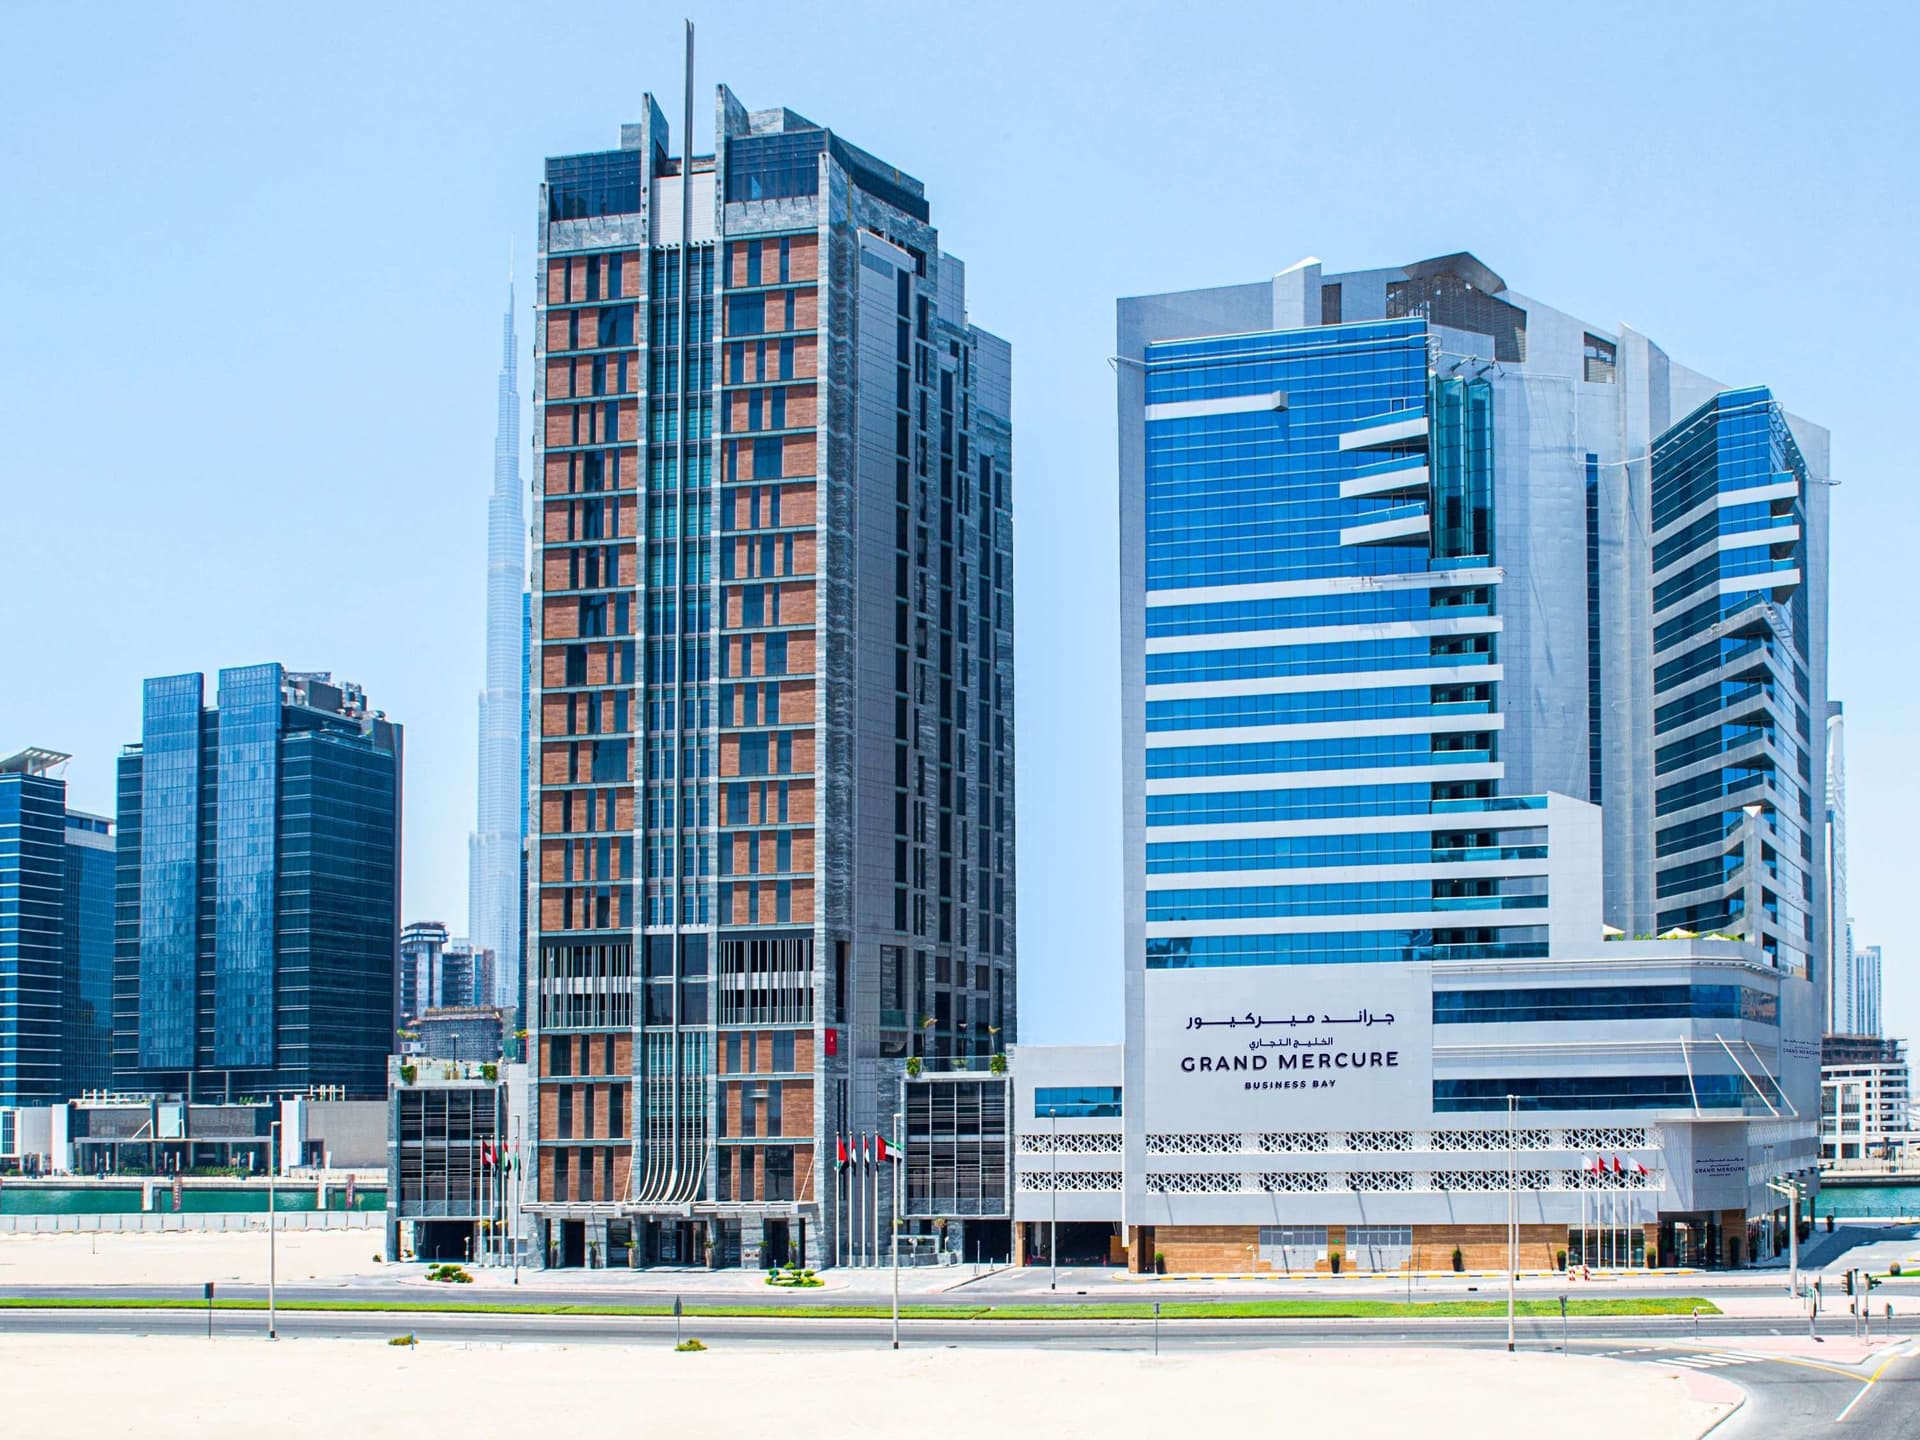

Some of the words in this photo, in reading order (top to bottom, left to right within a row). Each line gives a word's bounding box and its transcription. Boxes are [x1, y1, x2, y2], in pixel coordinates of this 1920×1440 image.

[1292, 1037, 1334, 1049] الخليج
[1180, 1055, 1268, 1073] GRAND
[1278, 1051, 1399, 1070] MERCURE
[1244, 1080, 1307, 1090] BUSINESS
[1312, 1079, 1336, 1089] BAY
